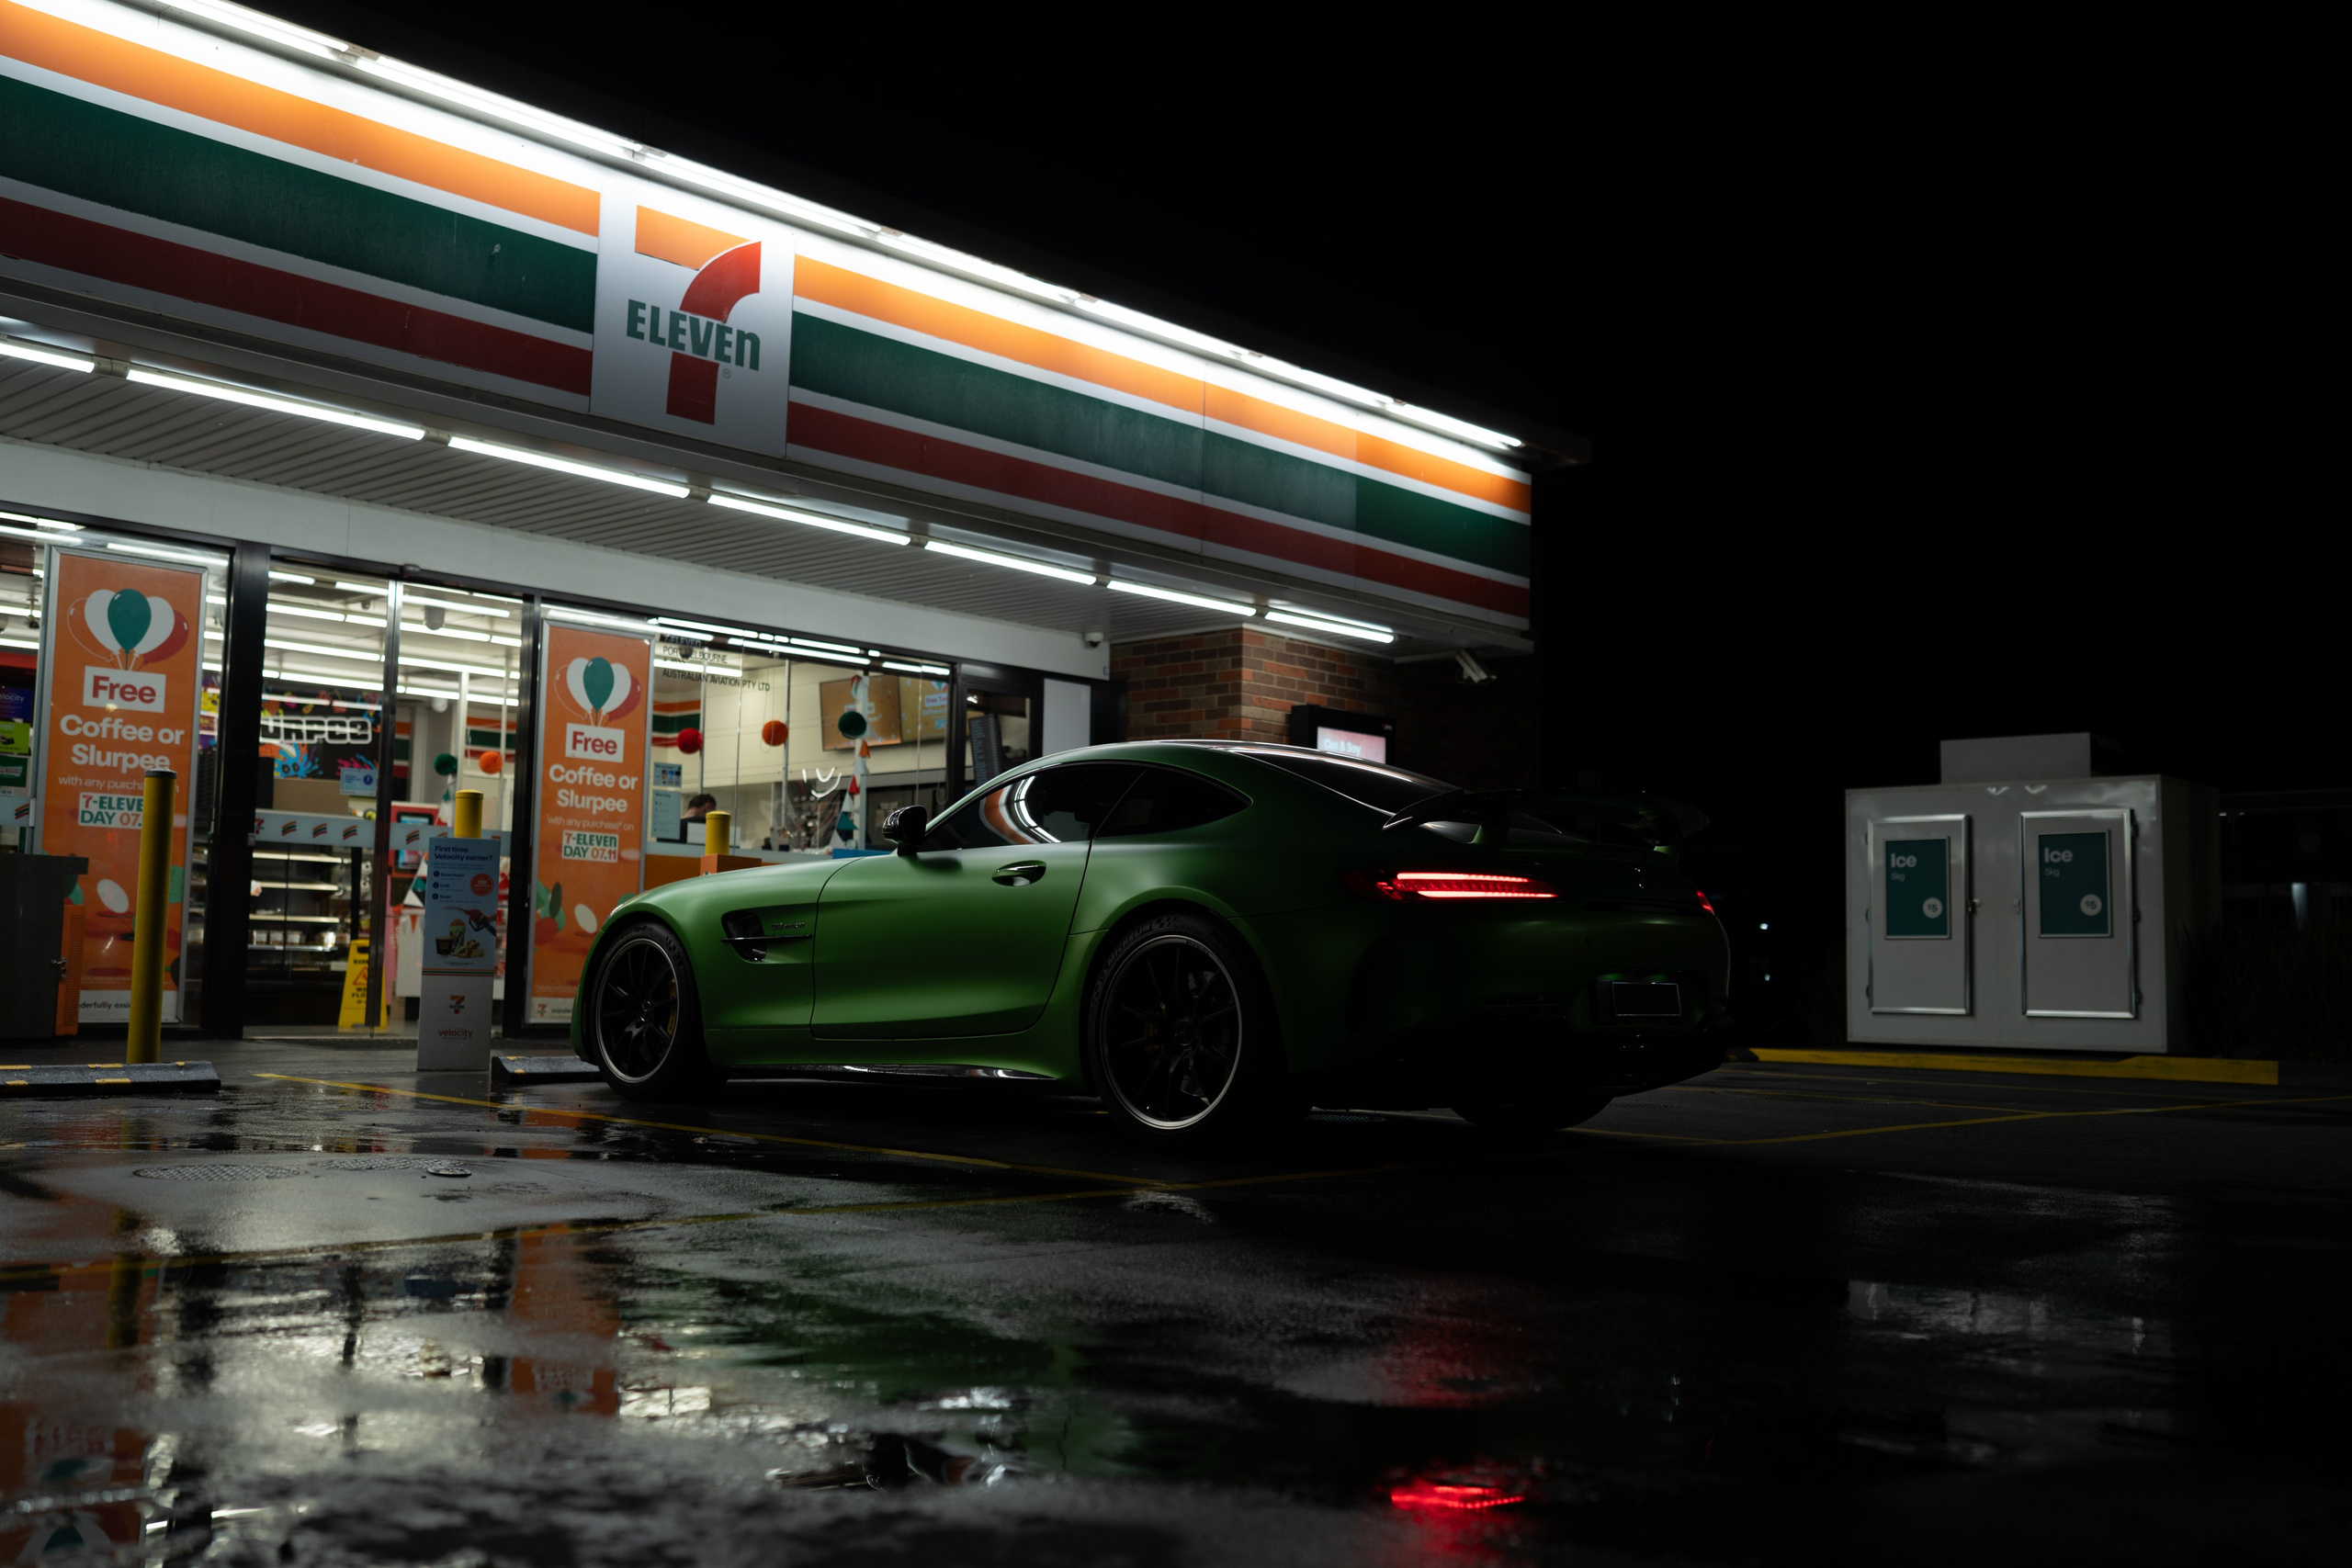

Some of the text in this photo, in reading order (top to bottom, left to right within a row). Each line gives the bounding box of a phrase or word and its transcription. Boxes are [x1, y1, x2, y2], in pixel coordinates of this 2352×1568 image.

[635, 205, 762, 425] 7
[662, 669, 707, 682] AUSTRALIAN
[710, 677, 740, 687] AVIATION
[758, 682, 770, 692] LTD
[93, 675, 156, 704] Free
[60, 714, 185, 745] Coffee or
[572, 731, 617, 755] Free
[72, 743, 170, 774] Slurpee
[59, 775, 144, 791] with any purcha
[549, 763, 639, 790] Coffee or
[82, 795, 144, 812] 7-ELEVE
[557, 789, 628, 815] Slurpee
[80, 810, 142, 827] DAY 07.
[548, 815, 565, 825] with
[567, 818, 582, 828] any
[624, 823, 634, 831] on
[435, 853, 464, 862] Velocity
[563, 845, 616, 861] DAY 07.11
[1891, 852, 1917, 868] Ice
[2044, 847, 2073, 863] Ice
[1891, 873, 1905, 882] 5kg
[2044, 868, 2060, 877] 5kg
[1107, 922, 1151, 966] MICHELIN
[438, 1029, 473, 1038] velocity
